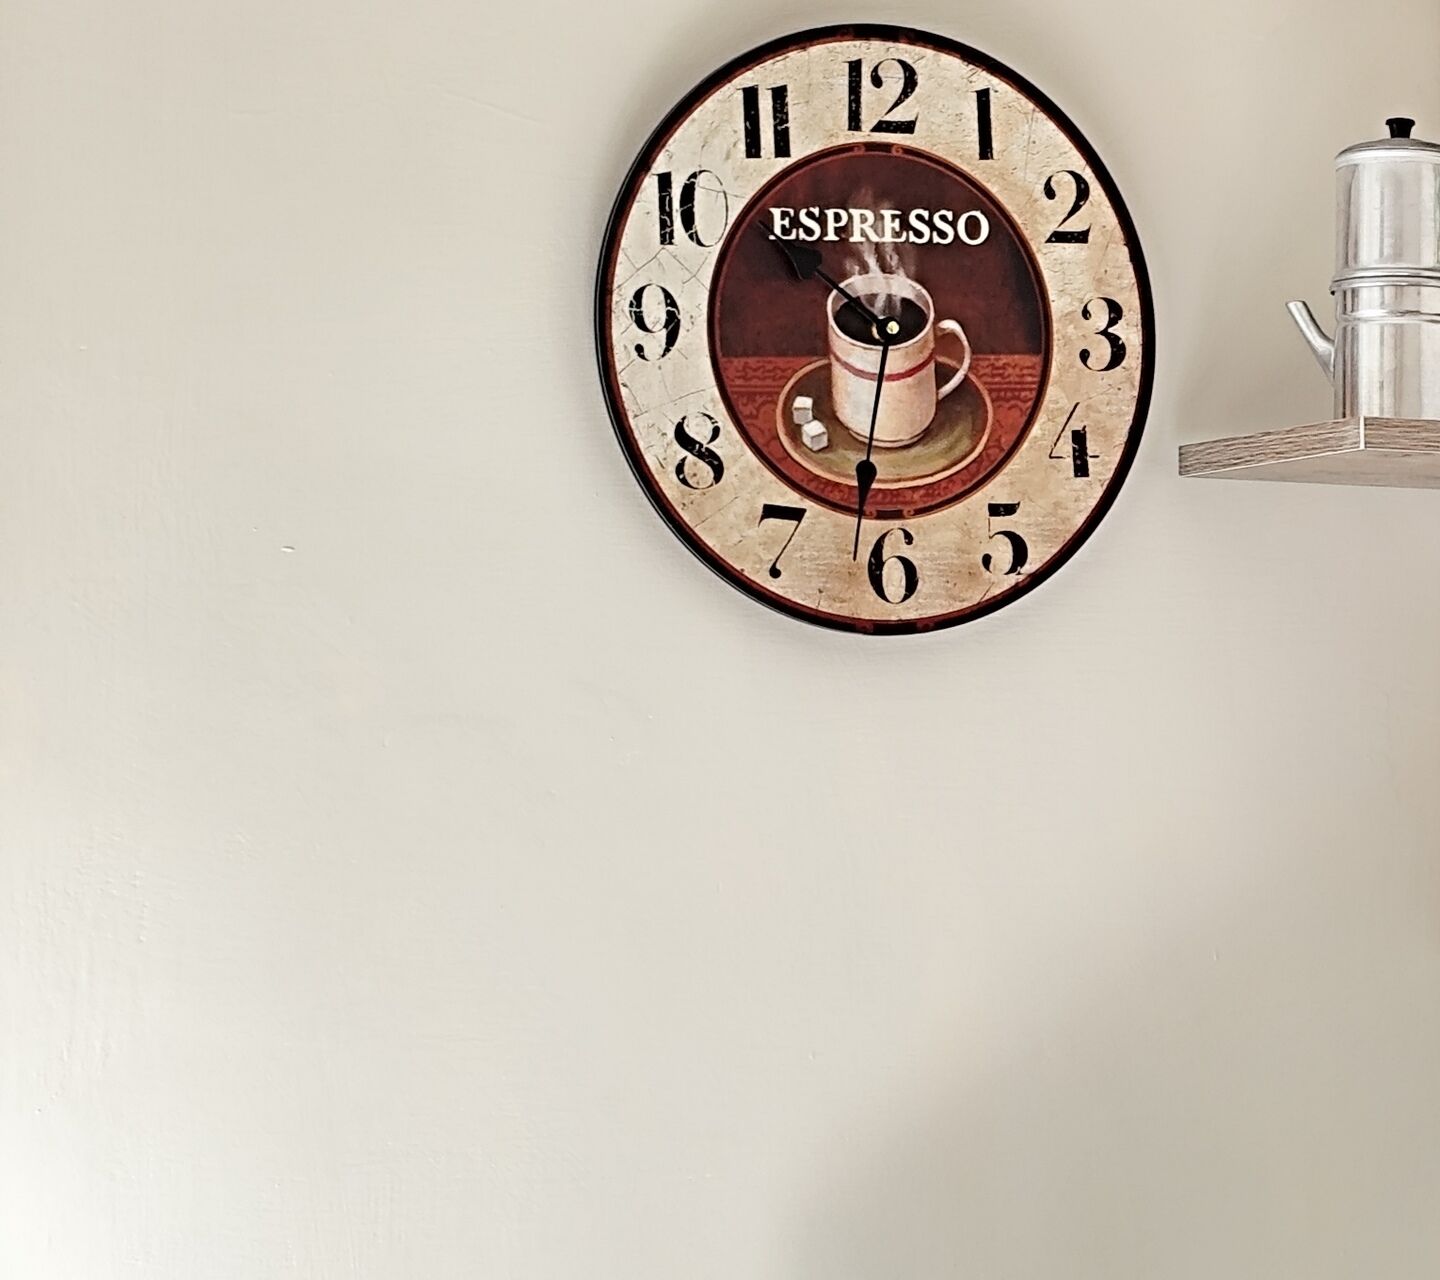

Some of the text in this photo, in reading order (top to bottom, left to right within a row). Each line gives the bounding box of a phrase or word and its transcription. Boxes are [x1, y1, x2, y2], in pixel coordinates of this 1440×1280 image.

[738, 84, 792, 159] 11
[843, 58, 920, 134] 12
[971, 87, 996, 161] 1
[651, 169, 730, 248] 10
[768, 206, 990, 246] ESPRESSO
[1043, 169, 1092, 245] 2
[628, 283, 682, 362] 9
[1079, 297, 1127, 372] 3
[673, 411, 725, 490] 8
[1048, 402, 1100, 478] 4
[757, 503, 808, 580] 7
[867, 527, 920, 605] 6
[981, 501, 1029, 577] 5
